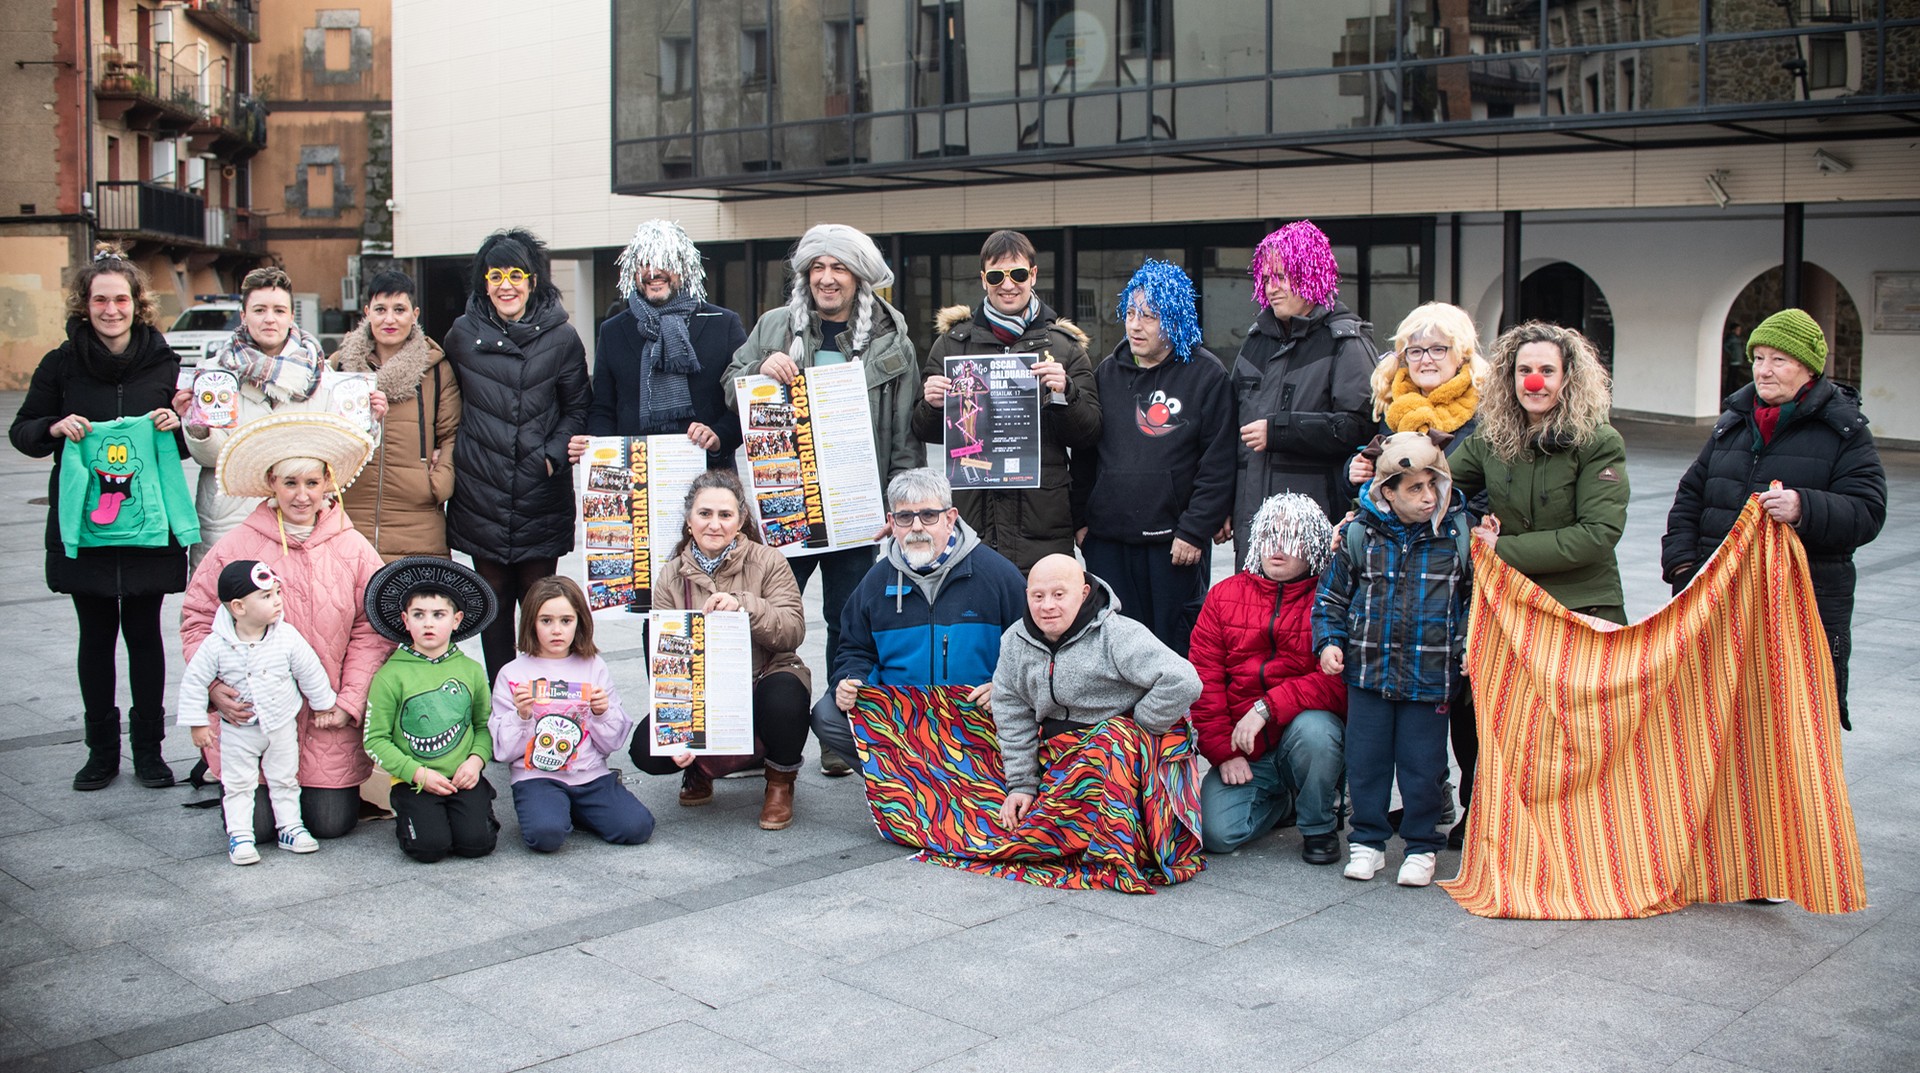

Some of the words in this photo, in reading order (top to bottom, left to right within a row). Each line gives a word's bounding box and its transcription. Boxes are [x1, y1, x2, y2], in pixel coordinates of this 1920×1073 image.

[990, 360, 1016, 369] OSCAR
[990, 380, 1008, 390] BILA
[790, 374, 809, 419] 2023
[630, 441, 647, 485] 2023
[795, 421, 825, 525] INAUTERIAK
[632, 487, 650, 590] INAUTERIAK
[691, 617, 704, 651] 2023
[537, 685, 582, 699] Halloween
[692, 653, 705, 732] INAUTERIAK
